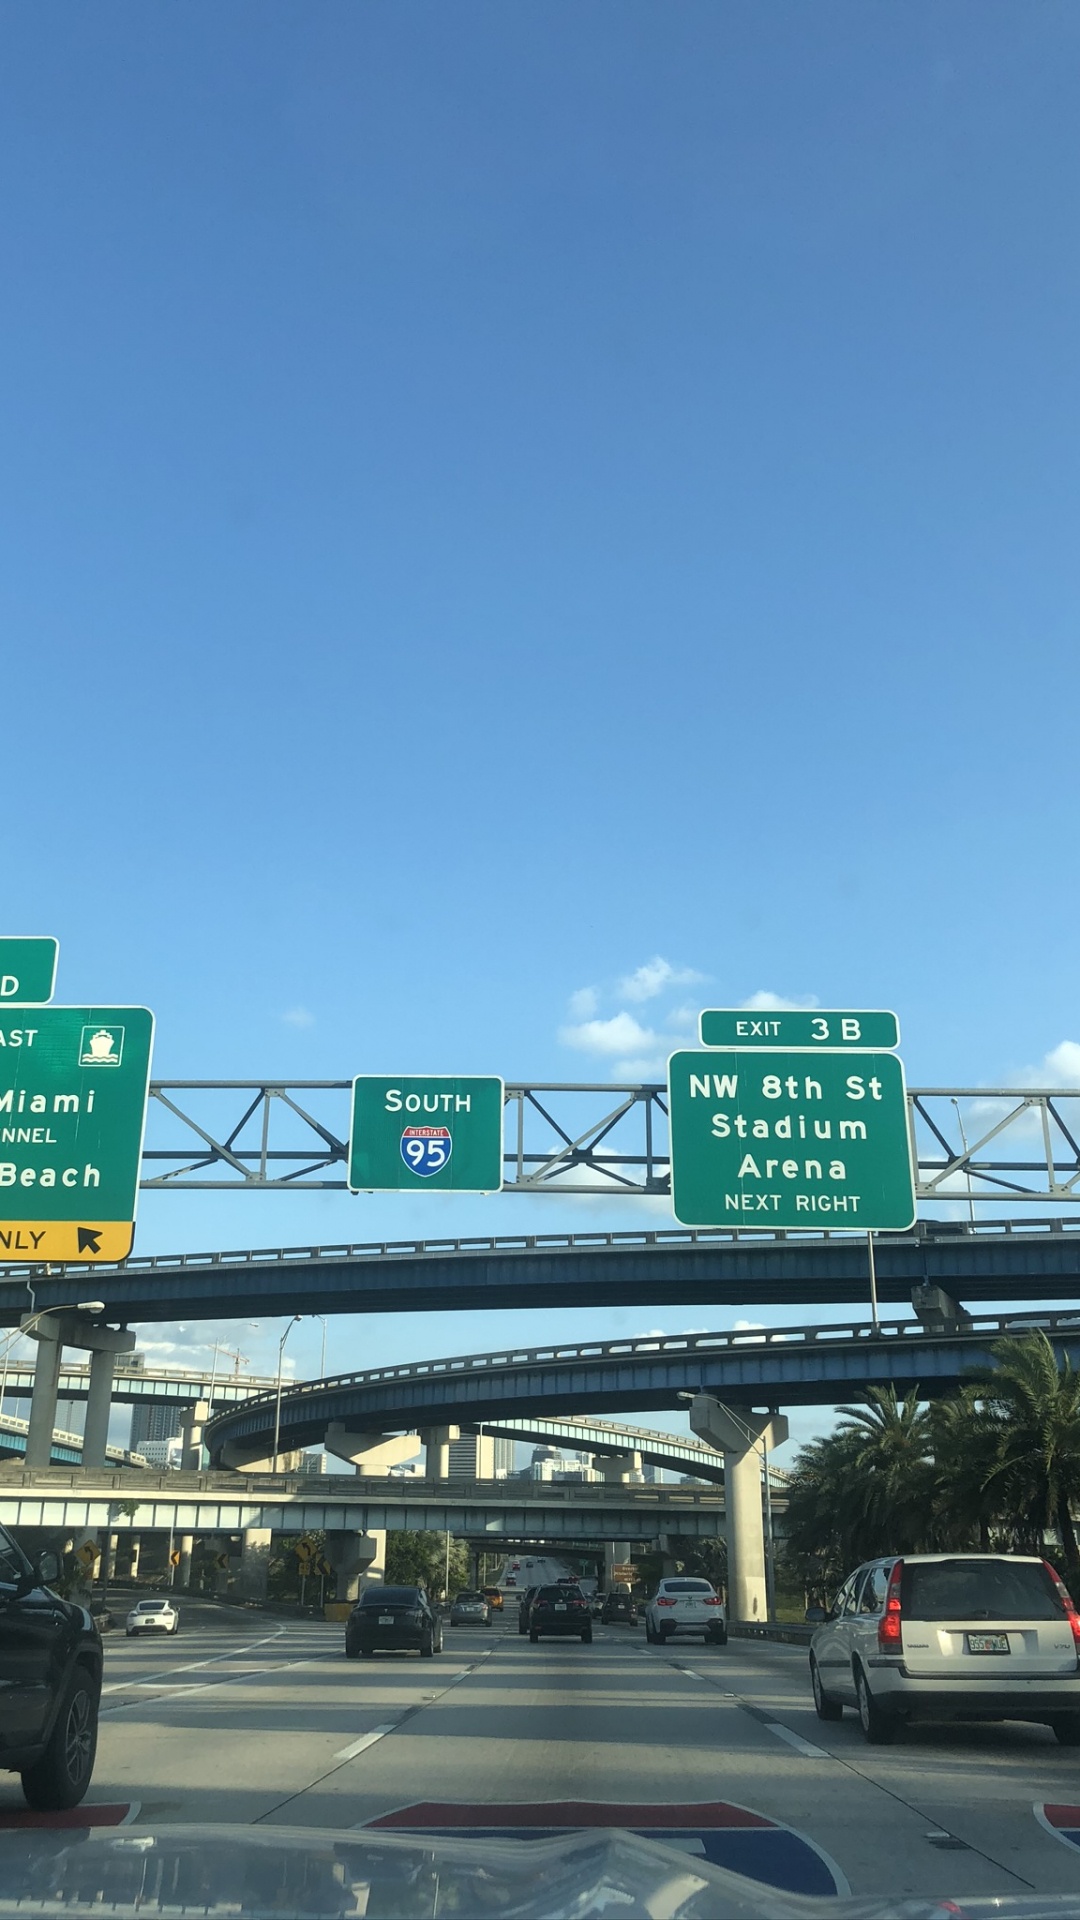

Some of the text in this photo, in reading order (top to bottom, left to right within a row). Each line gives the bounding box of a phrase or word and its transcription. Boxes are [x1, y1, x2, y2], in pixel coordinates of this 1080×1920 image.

[1, 975, 19, 997] D
[737, 1019, 861, 1040] EXIT 3 B
[690, 1075, 881, 1100] NW 8th St
[385, 1090, 470, 1112] SOUTH
[712, 1114, 866, 1139] Stadium
[406, 1140, 446, 1167] 95
[0, 1163, 99, 1186] Beach
[738, 1154, 845, 1179] Arena
[726, 1194, 860, 1211] NEXT RIGHT
